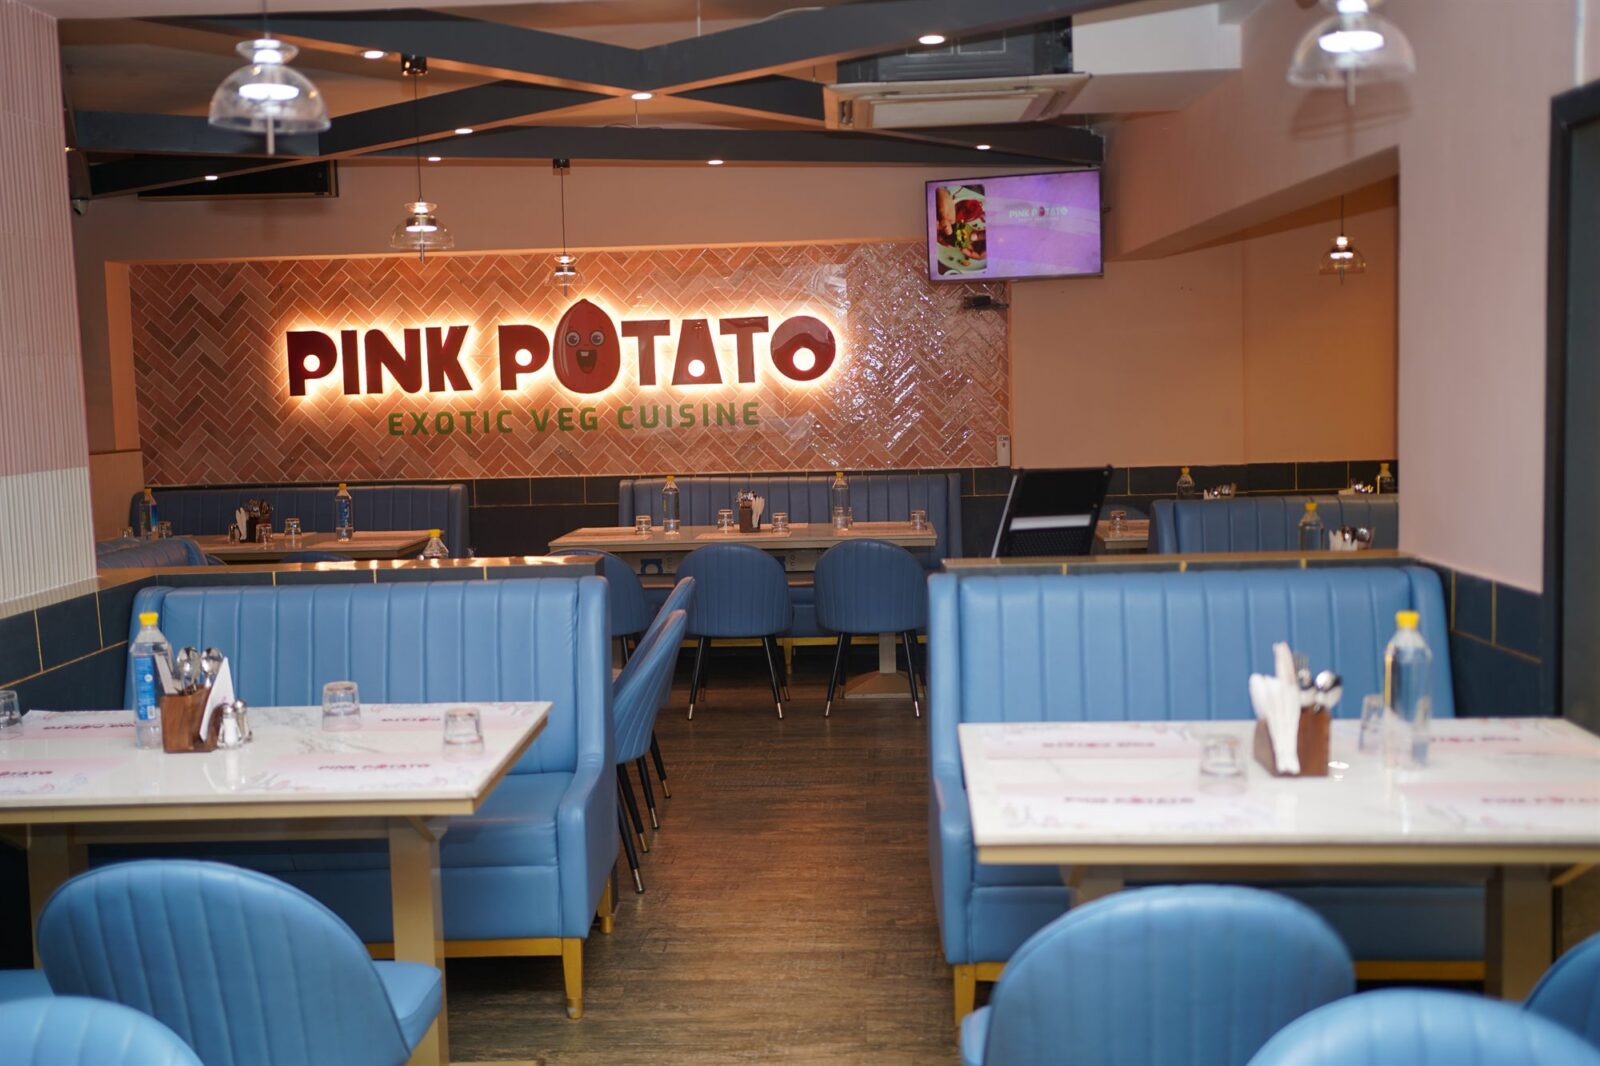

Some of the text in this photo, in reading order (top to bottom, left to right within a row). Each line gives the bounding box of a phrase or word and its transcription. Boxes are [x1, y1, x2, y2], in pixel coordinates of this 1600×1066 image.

[286, 298, 836, 396] PINK POTATO
[388, 402, 760, 436] EXOTIC VEG CUISINE
